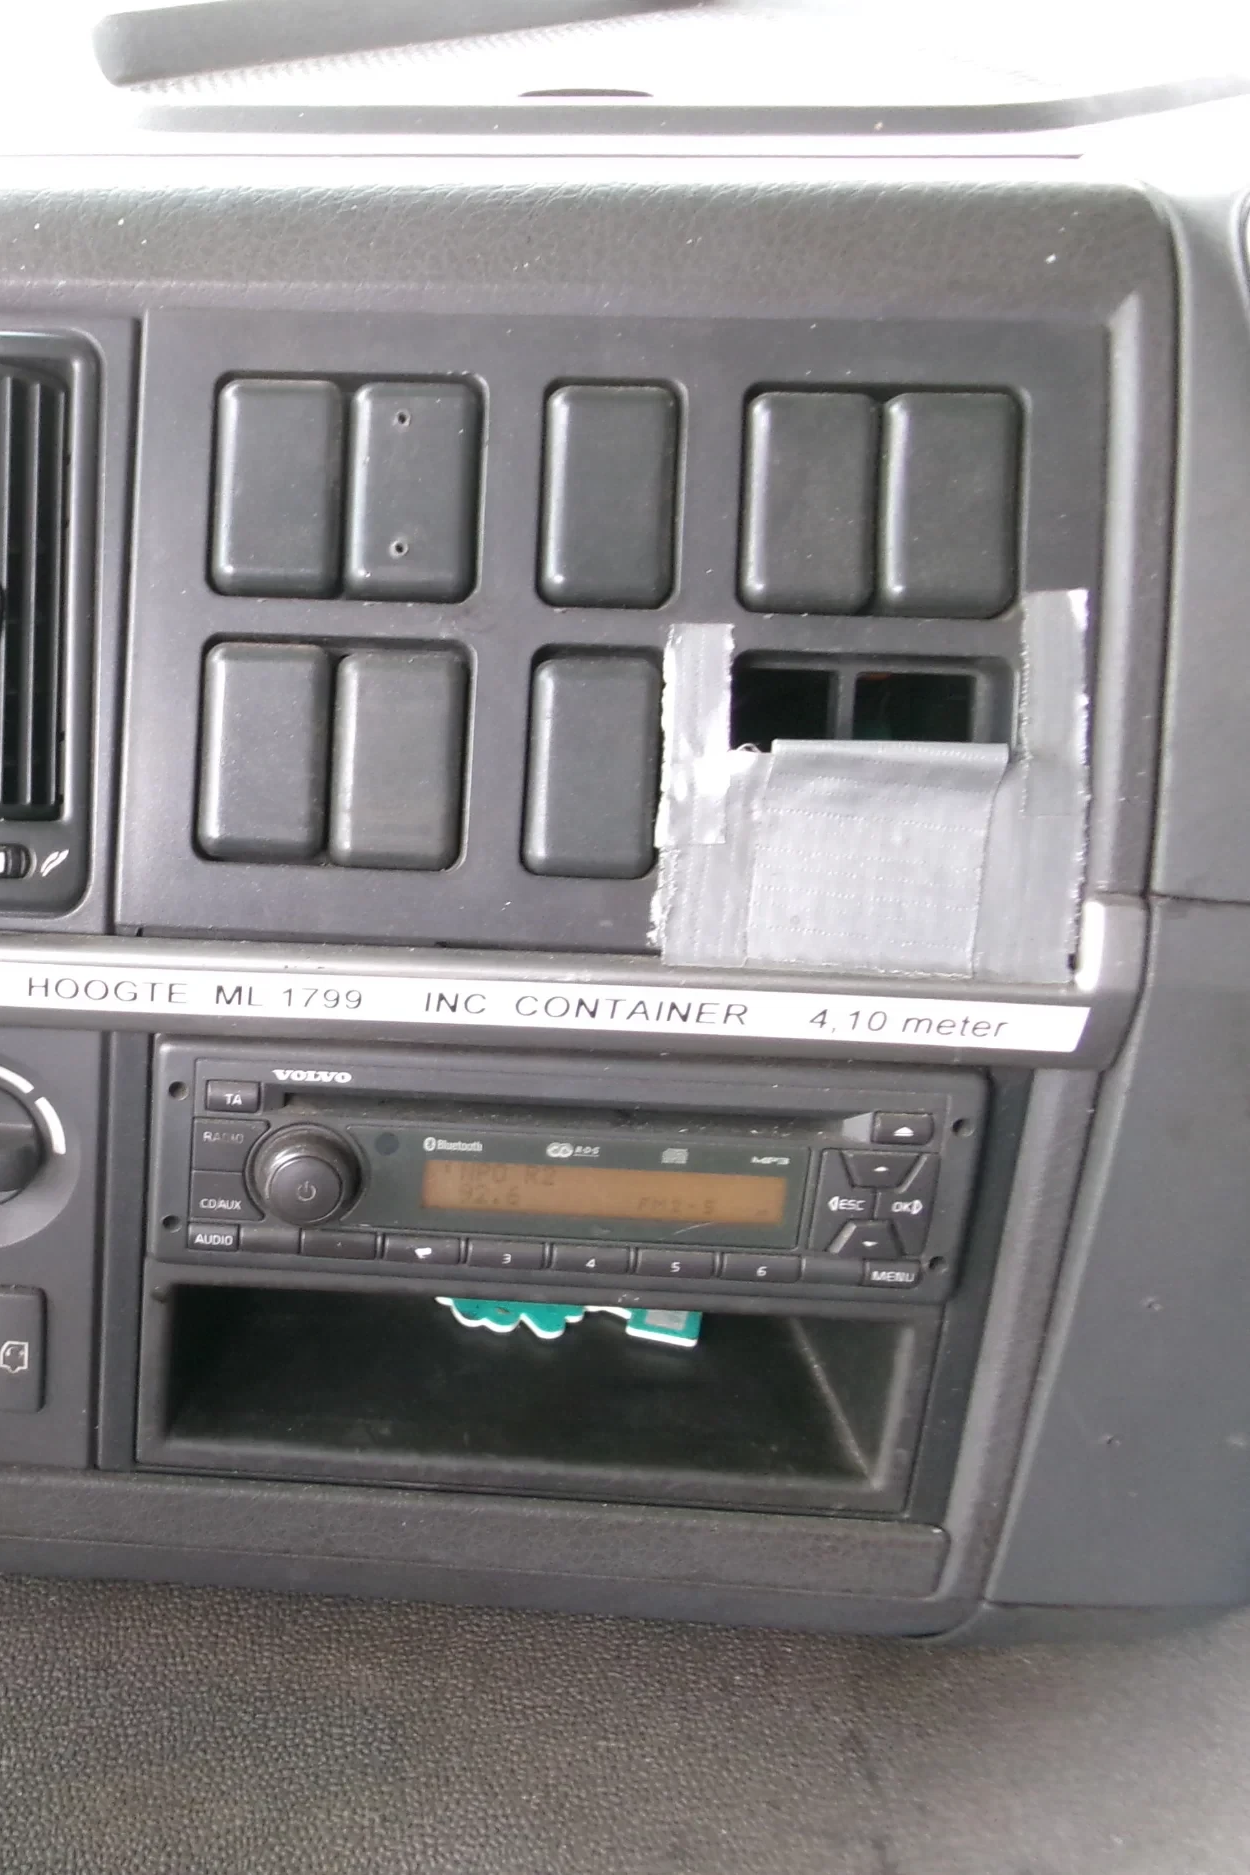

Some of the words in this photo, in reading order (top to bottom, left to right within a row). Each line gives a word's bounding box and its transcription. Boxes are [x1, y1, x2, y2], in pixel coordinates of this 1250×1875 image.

[27, 976, 189, 1004] HOOGTE
[214, 986, 264, 1006] ML
[282, 988, 363, 1010] 1799
[425, 992, 487, 1014] INC
[515, 995, 750, 1026] CONTAINER
[808, 1008, 890, 1032] 4,10
[901, 1015, 1010, 1039] meter
[272, 1069, 352, 1083] VOLVO
[224, 1093, 243, 1105] TA
[437, 1139, 483, 1152] Bluetooth
[751, 1156, 790, 1165] MP3
[838, 1198, 866, 1212] ESC
[891, 1201, 913, 1213] OK
[194, 1233, 234, 1246] AUDIO
[502, 1253, 512, 1265] 3
[585, 1258, 597, 1269] 4
[669, 1261, 681, 1273] 5
[756, 1265, 768, 1277] 6
[871, 1270, 915, 1283] MENU
